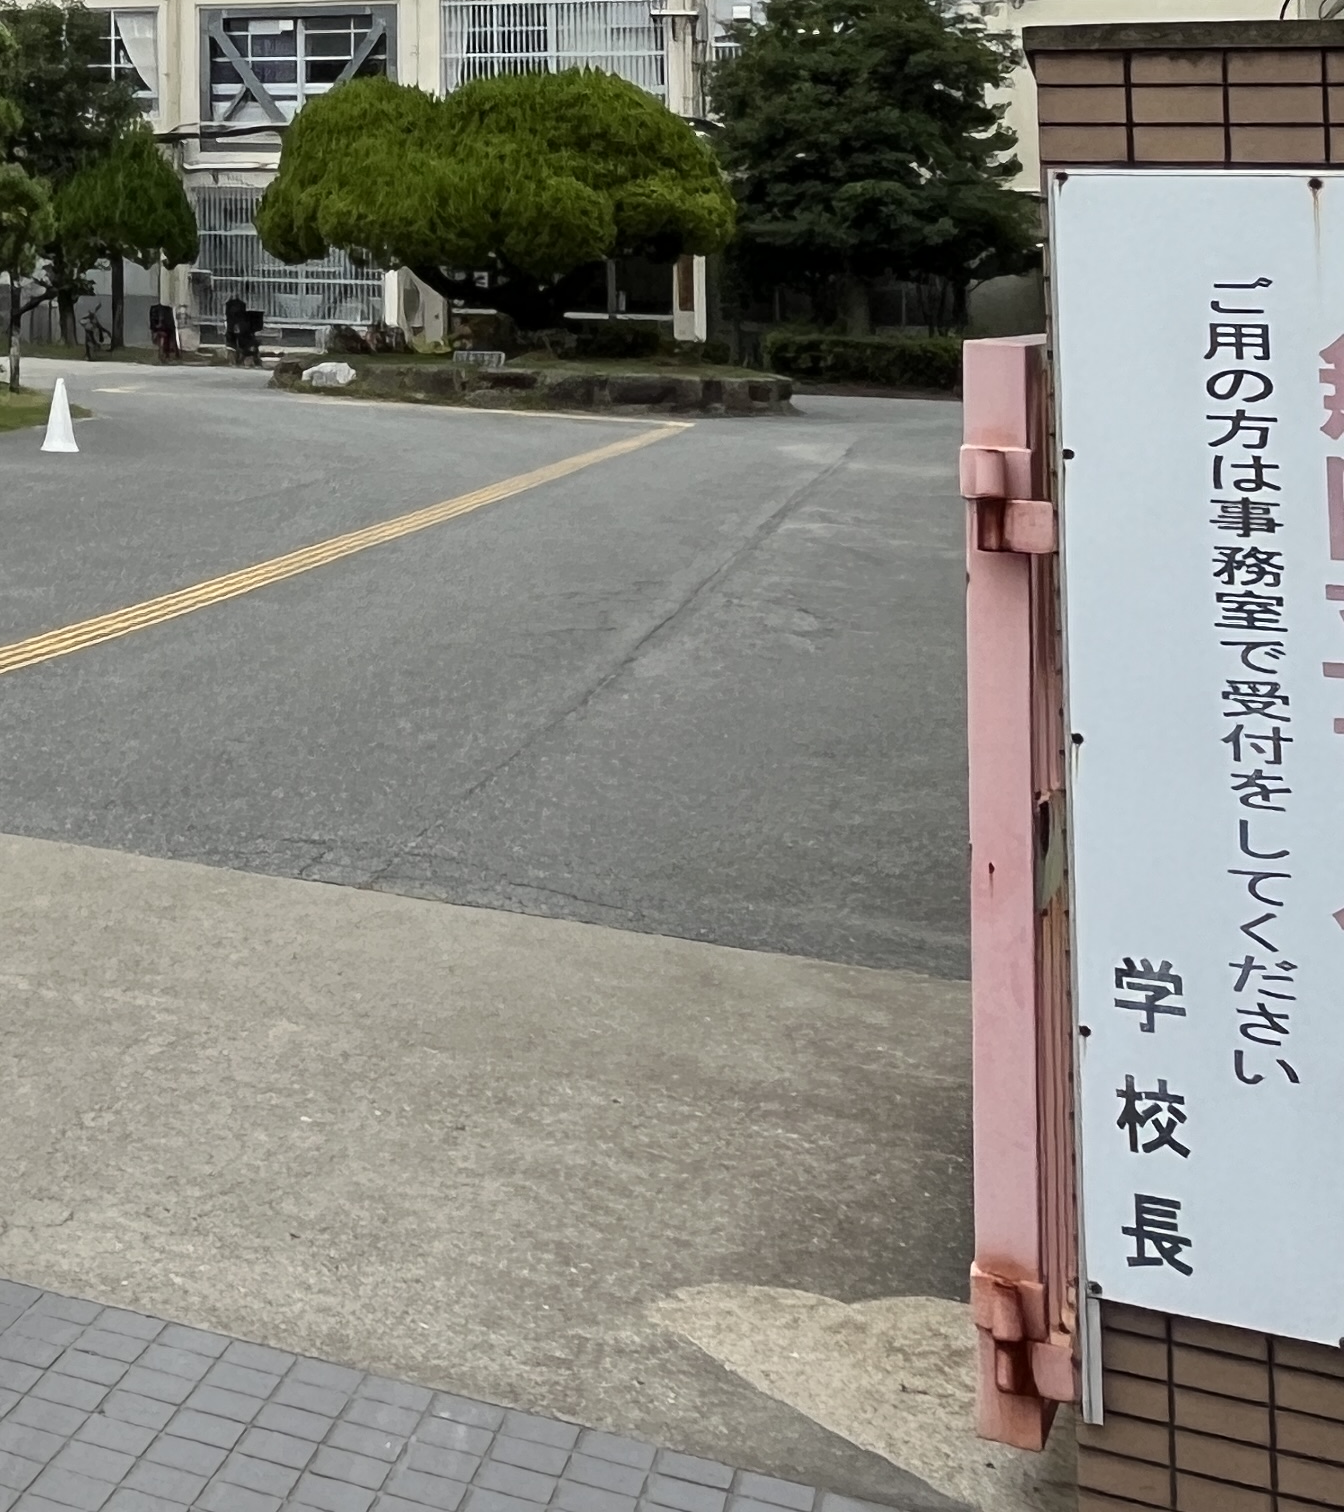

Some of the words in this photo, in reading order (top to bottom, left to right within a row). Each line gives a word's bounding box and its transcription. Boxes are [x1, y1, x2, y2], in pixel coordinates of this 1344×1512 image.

[1201, 276, 1302, 1087] ご用の方は事務室で受付をしてください
[1113, 956, 1193, 1276] 学校長
